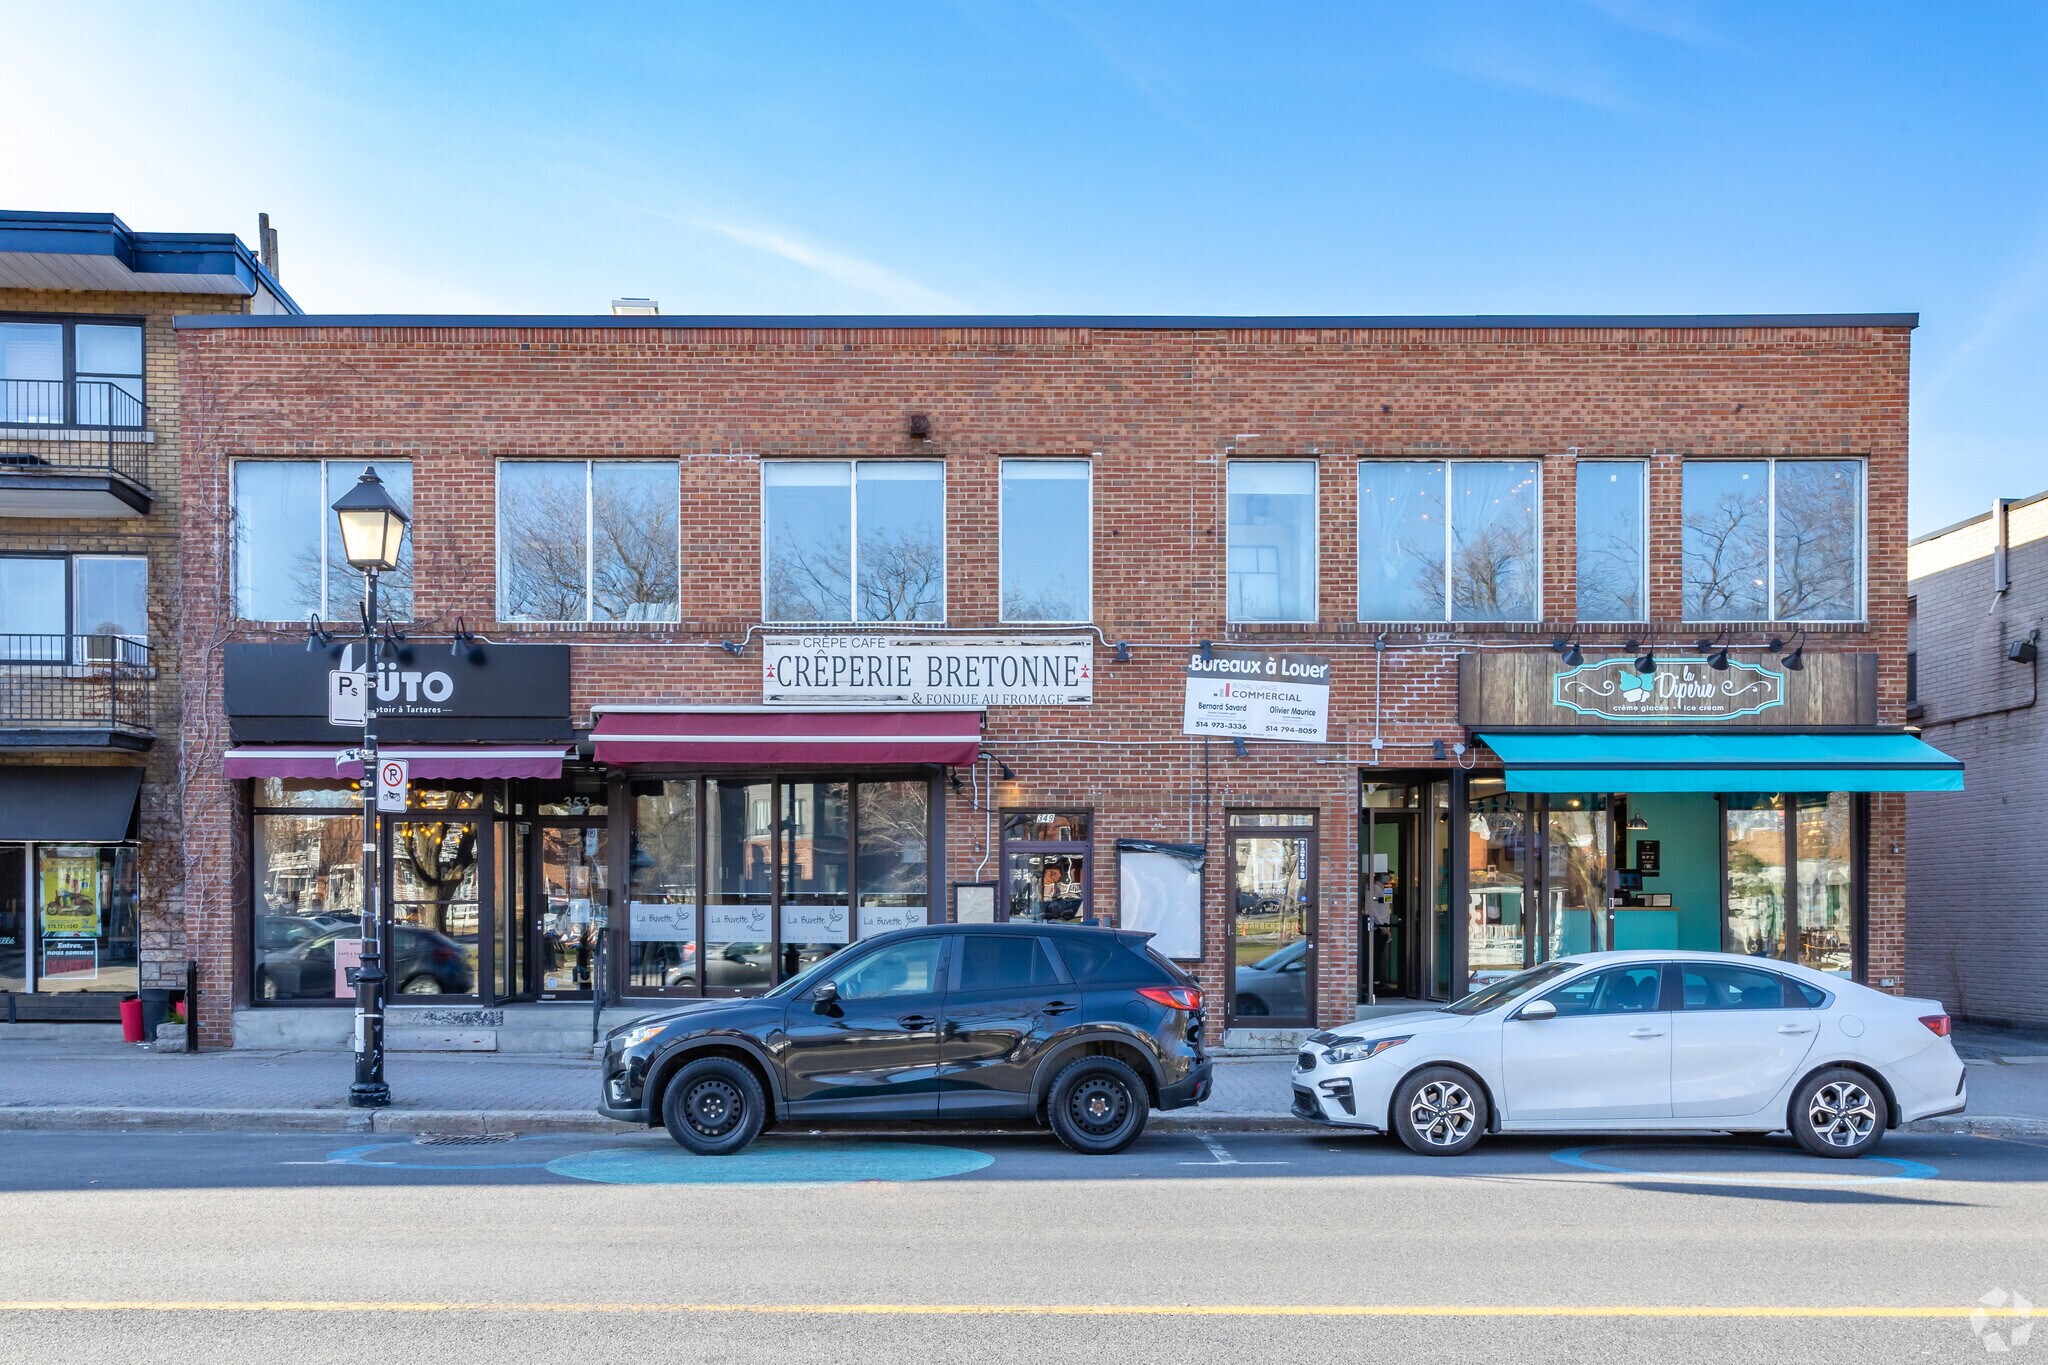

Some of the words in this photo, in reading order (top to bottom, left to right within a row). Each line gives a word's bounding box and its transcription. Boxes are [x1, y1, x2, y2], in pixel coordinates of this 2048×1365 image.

[803, 636, 847, 648] CRÊPE
[851, 636, 886, 648] CAFÉ
[777, 649, 912, 687] CRÊPERIE
[927, 656, 1079, 687] BRETONNE
[1191, 654, 1261, 674] Bureaux
[1265, 656, 1277, 675] à
[1281, 658, 1329, 678] Louer
[911, 692, 922, 704] &
[926, 694, 982, 704] FONDUE
[982, 694, 999, 704] AU
[1003, 694, 1064, 705] FROMAGE
[1231, 690, 1302, 702] COMMERCIAL
[398, 705, 403, 713] à
[406, 705, 441, 713] Tartares
[1198, 702, 1224, 711] Bernard
[1225, 703, 1247, 712] Savard
[1269, 706, 1290, 715] Olivier
[1291, 708, 1316, 717] Maurice
[1211, 722, 1247, 730] 973-3336
[1280, 726, 1318, 735] 794-8059
[563, 796, 590, 808] 353
[1037, 814, 1054, 822] 349
[649, 914, 673, 922] Buvette
[711, 915, 721, 923] La
[724, 915, 749, 924] Buvette
[788, 916, 797, 924] La
[801, 916, 826, 924] Buvette
[863, 917, 873, 925] La
[876, 917, 902, 926] Buvette
